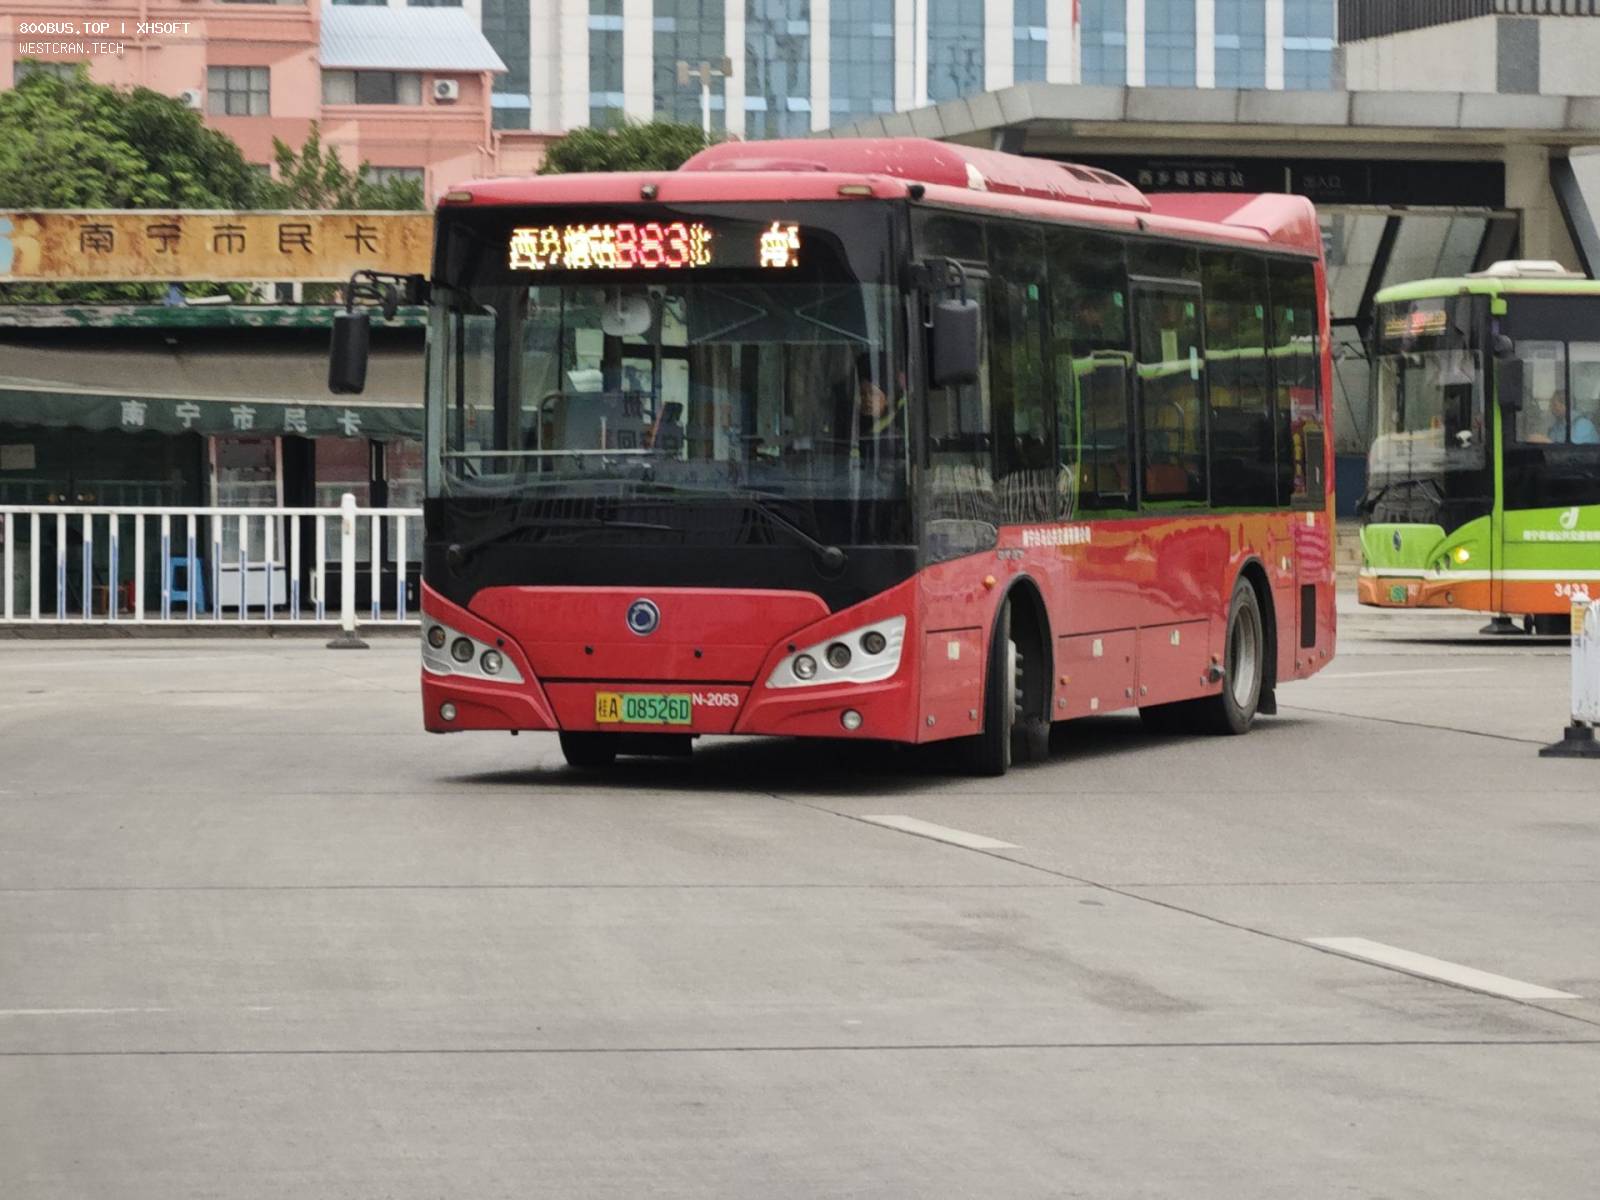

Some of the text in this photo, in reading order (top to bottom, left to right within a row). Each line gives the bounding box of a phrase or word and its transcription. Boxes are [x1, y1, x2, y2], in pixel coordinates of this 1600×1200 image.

[79, 223, 378, 255] 南宁市民卡
[120, 399, 363, 437] 南宁市民卡
[692, 692, 740, 707] N-2053
